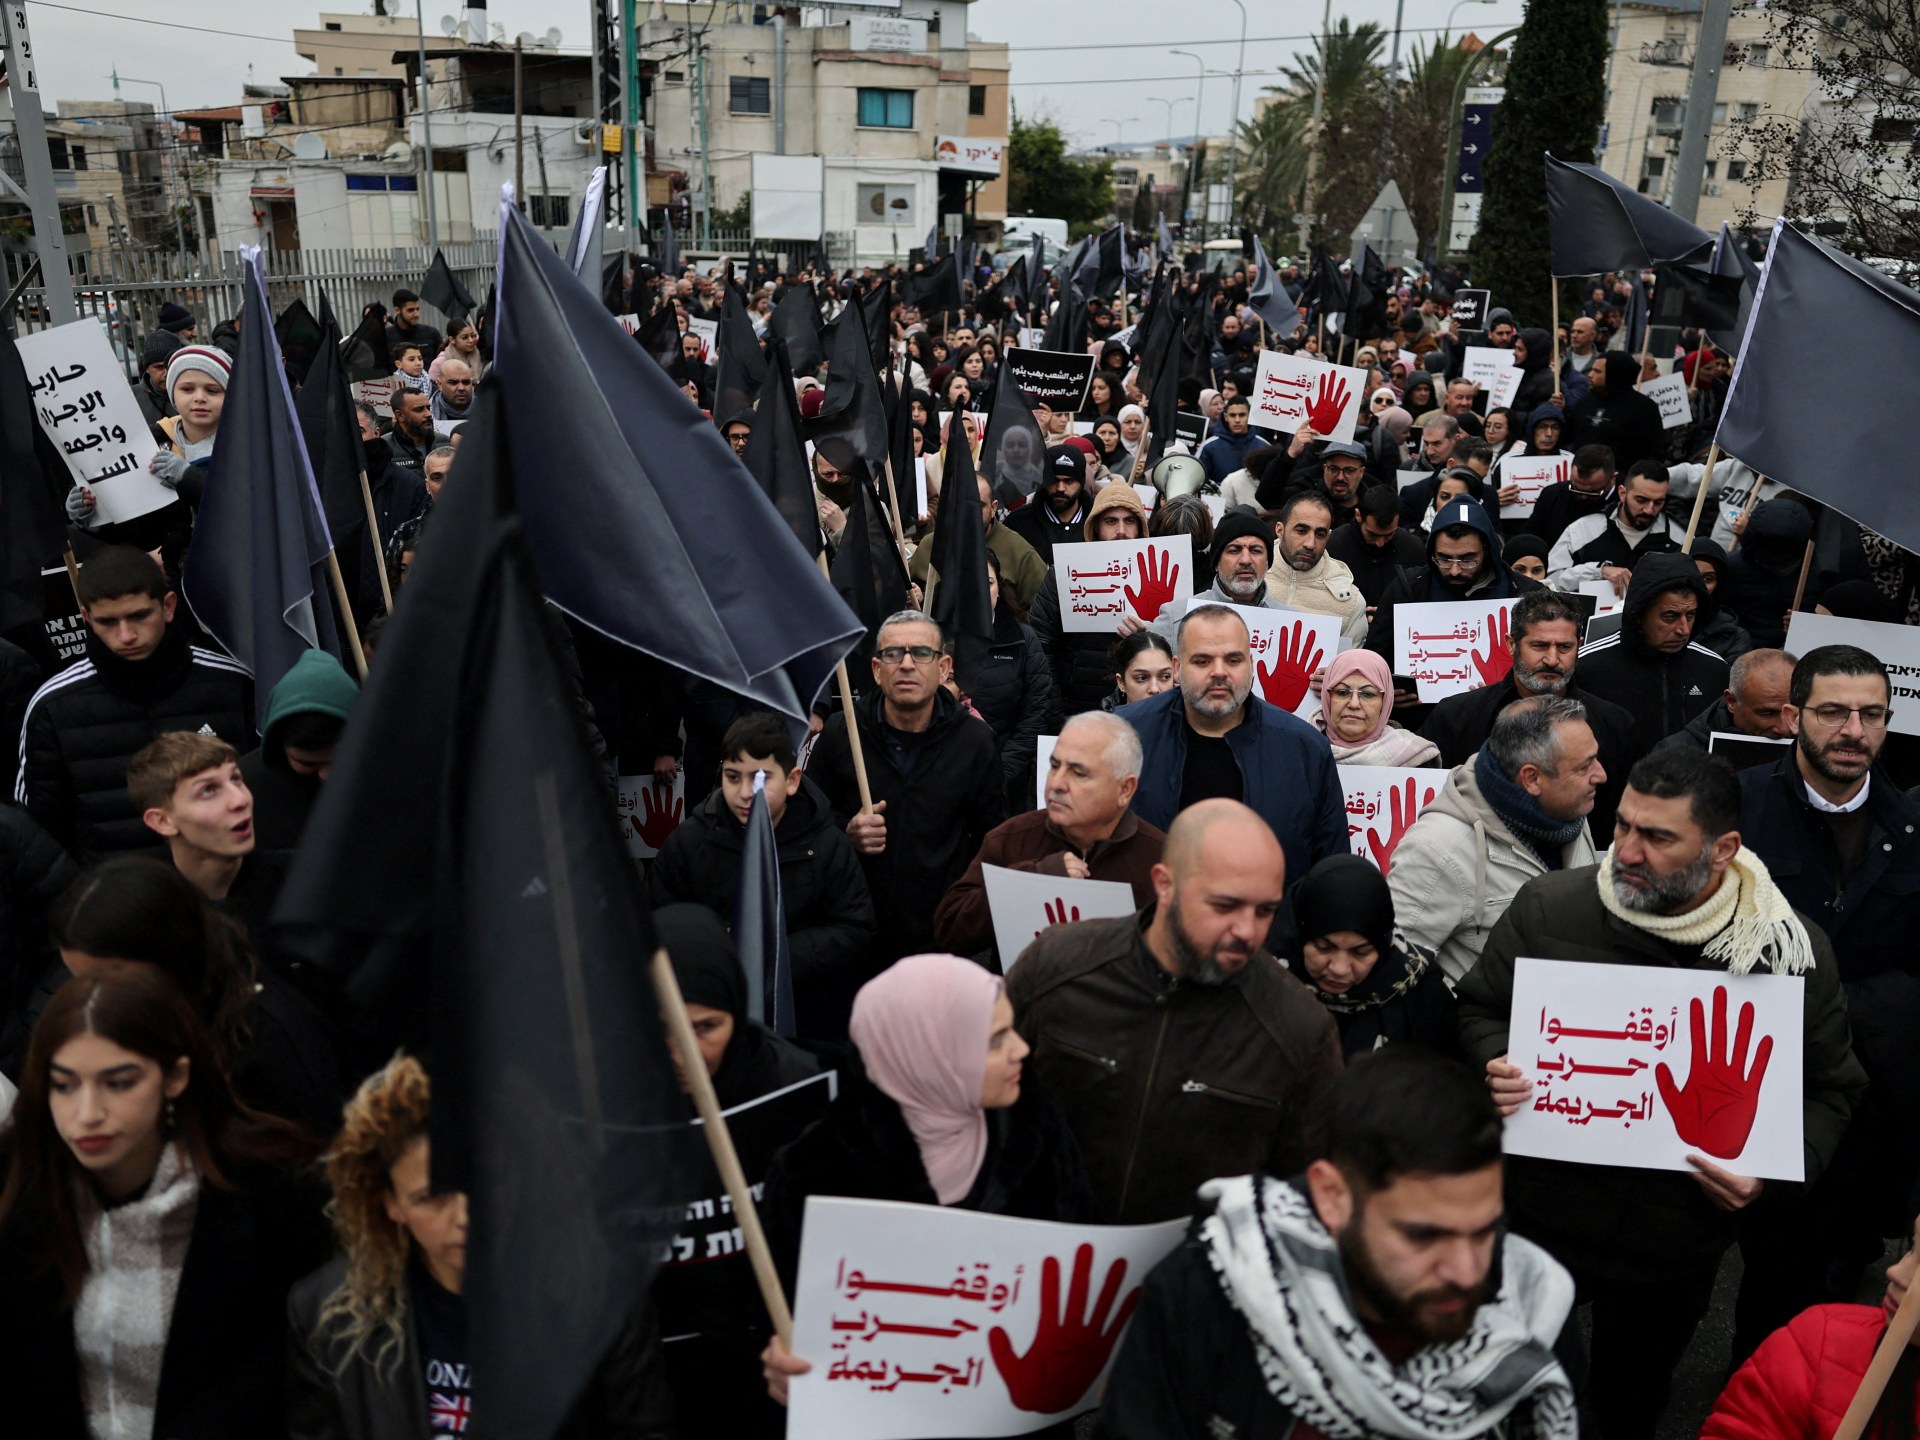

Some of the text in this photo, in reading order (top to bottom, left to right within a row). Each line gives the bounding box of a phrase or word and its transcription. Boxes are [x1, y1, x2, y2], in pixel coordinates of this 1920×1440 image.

[1265, 369, 1316, 392] أوقفوا
[1263, 387, 1303, 400] حرب
[1260, 397, 1304, 419] الجريمة
[1067, 558, 1131, 582] أوقفوا
[1069, 584, 1121, 598] حرب
[1072, 598, 1126, 616] الجريمة
[1408, 620, 1481, 644] أوقفوا
[1409, 648, 1467, 662] حرب
[1409, 663, 1471, 684] الجريمة
[1540, 1006, 1678, 1051] أوقفوا
[1537, 1052, 1649, 1081] حرب
[1534, 1080, 1653, 1129] الجريمة
[836, 1257, 1024, 1312] أوقفوا
[832, 1311, 979, 1342] حرب
[828, 1343, 984, 1394] الجريمة
